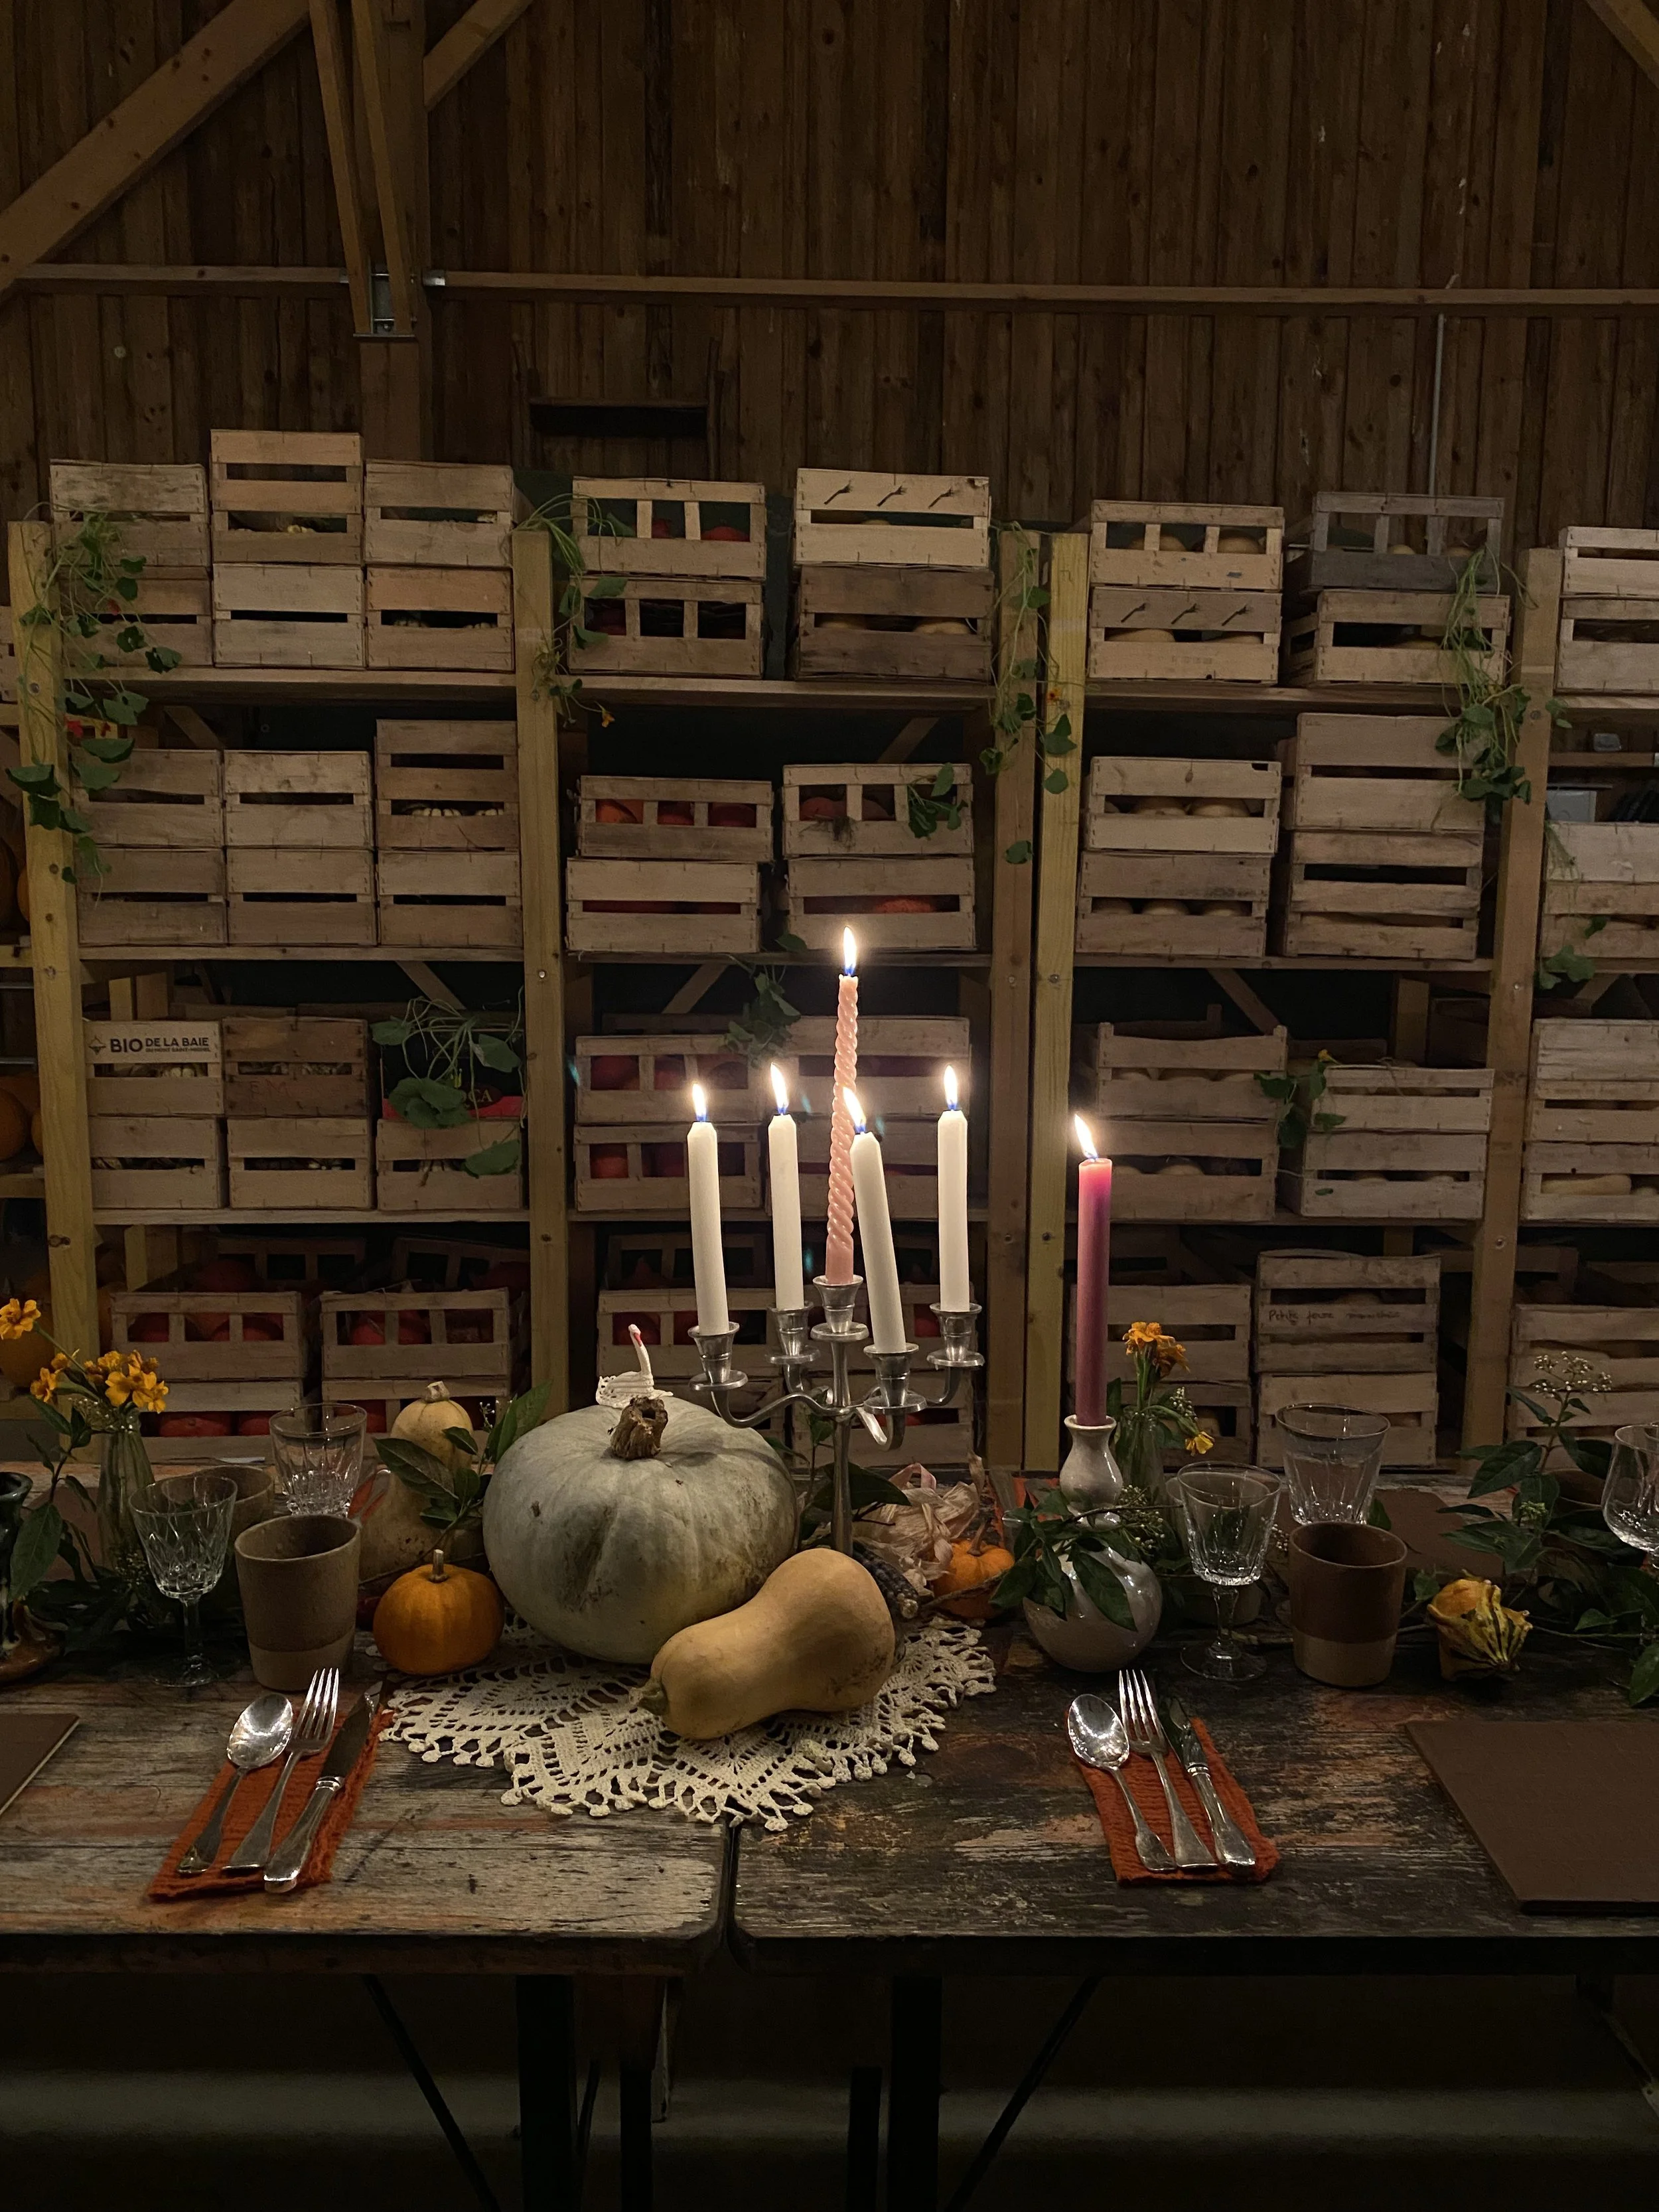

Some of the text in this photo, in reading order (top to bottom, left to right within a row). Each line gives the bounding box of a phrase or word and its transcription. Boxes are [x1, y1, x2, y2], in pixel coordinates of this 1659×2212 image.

[110, 1037, 209, 1053] BIO DE LA BAIE
